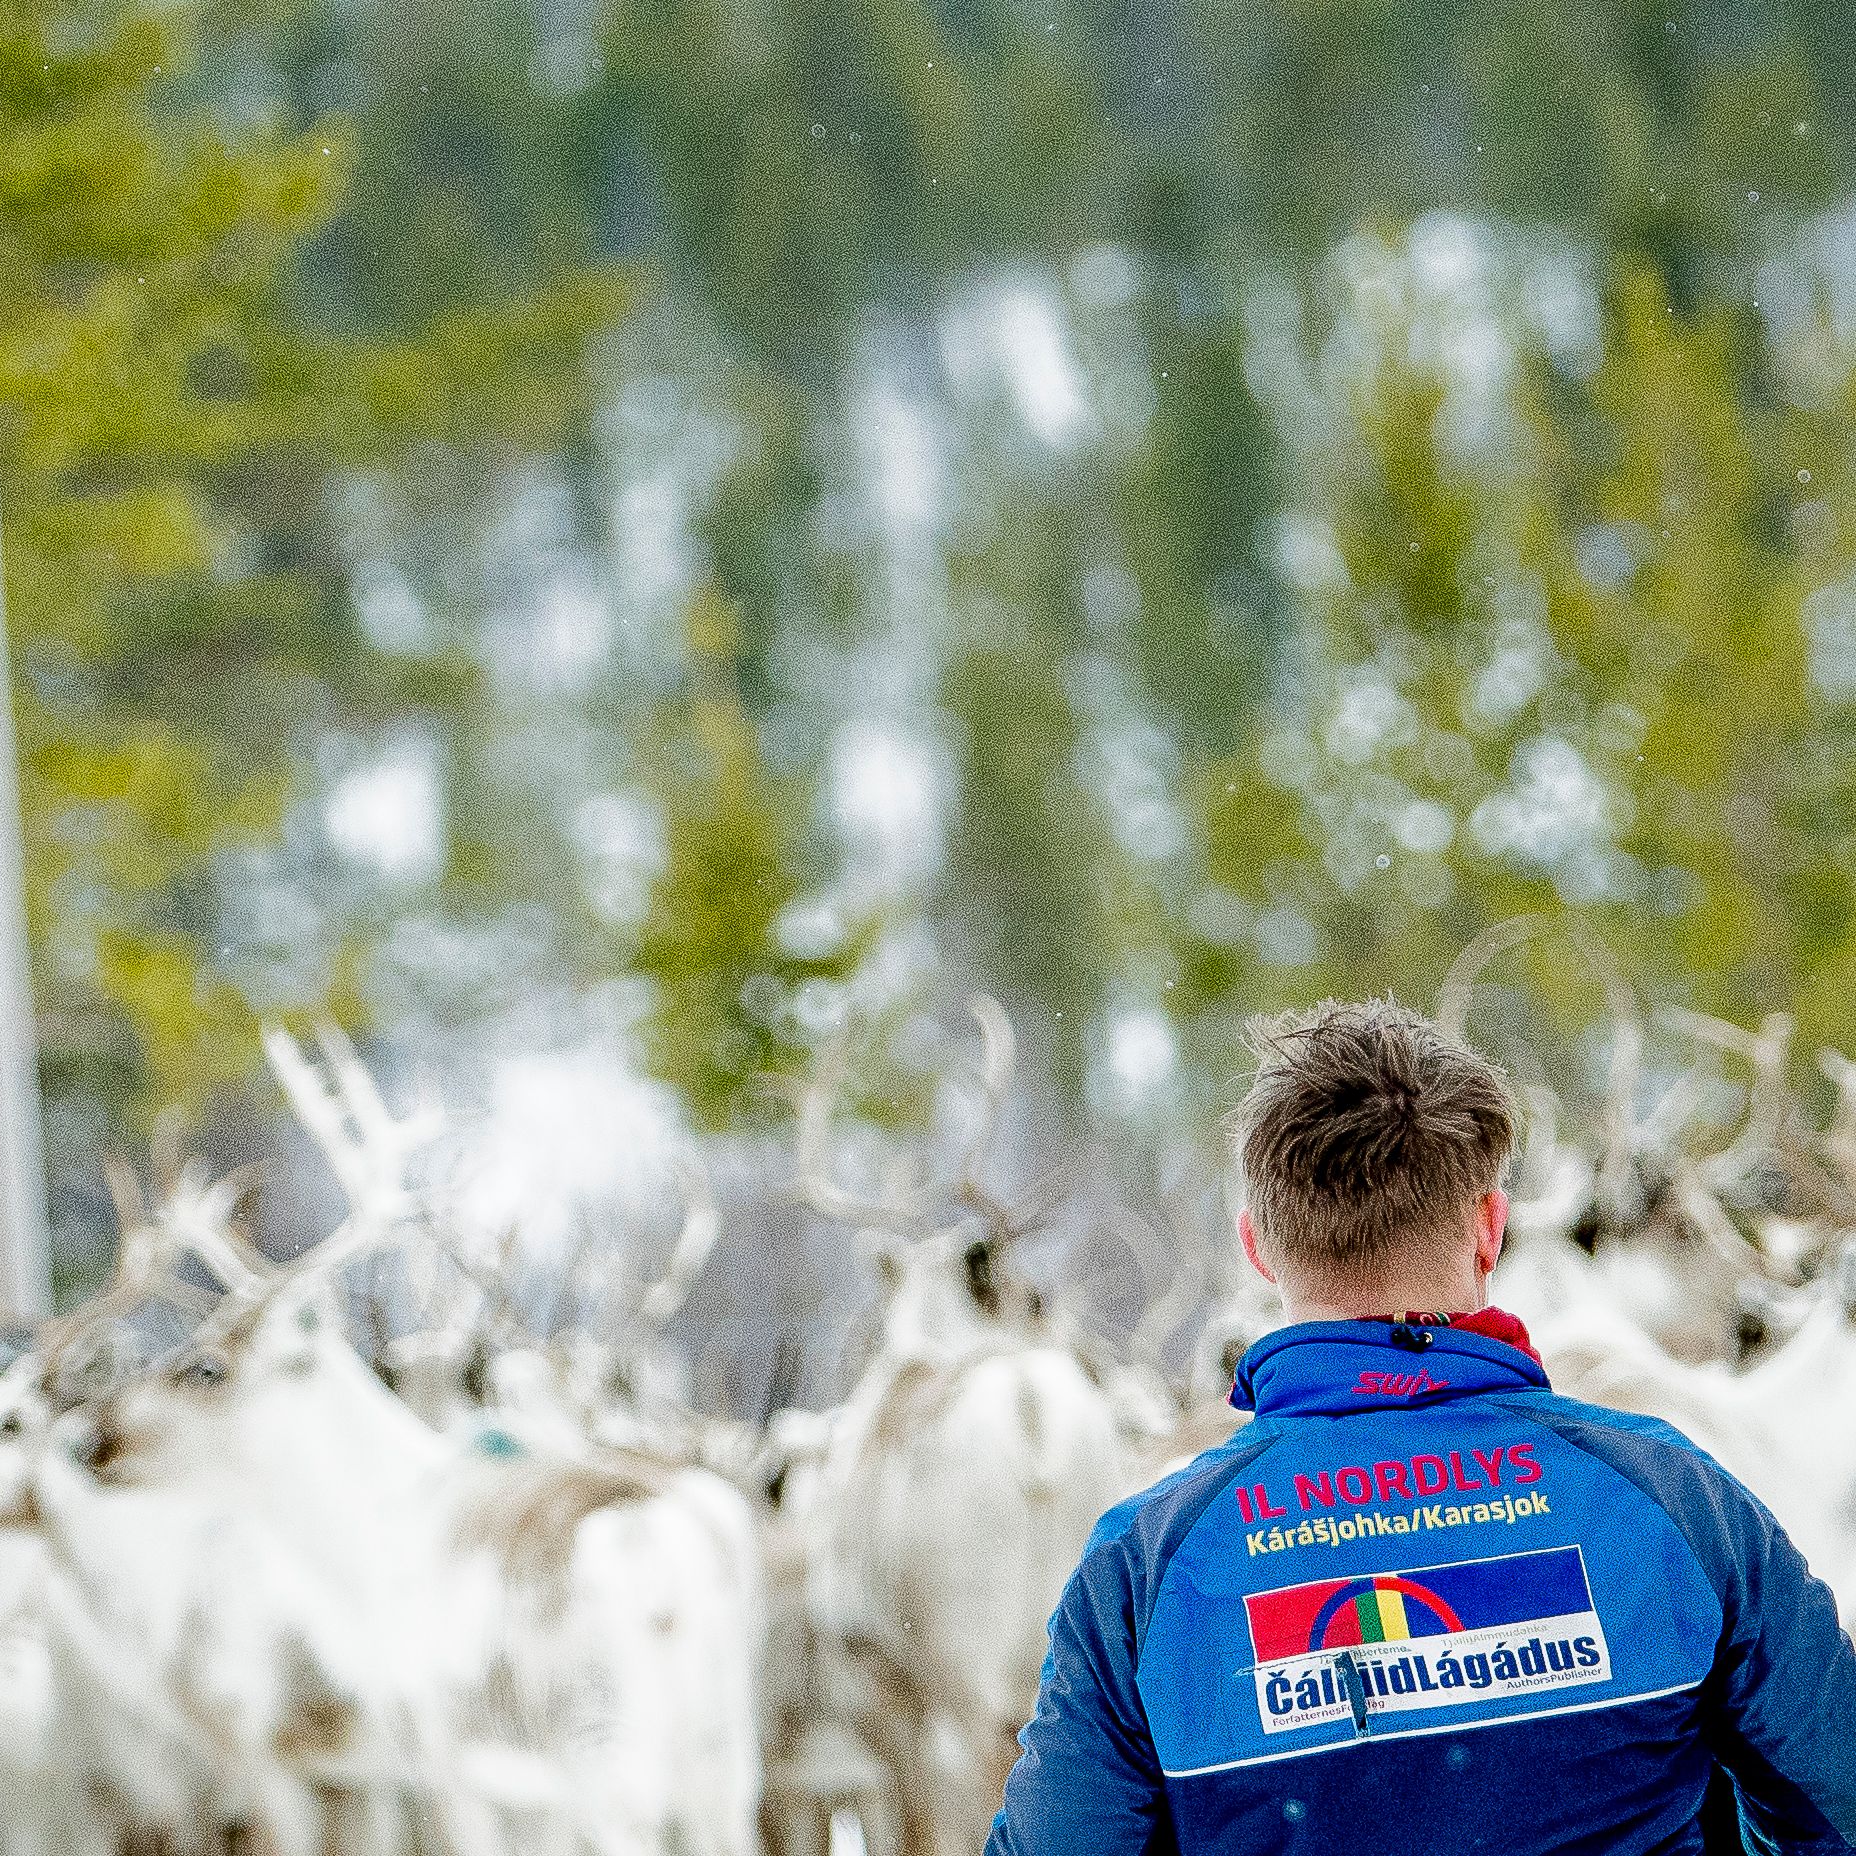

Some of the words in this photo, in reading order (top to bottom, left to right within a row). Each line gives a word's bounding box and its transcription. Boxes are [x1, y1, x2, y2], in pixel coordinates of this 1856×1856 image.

[1235, 1482, 1288, 1524] IL
[1293, 1443, 1543, 1512] NORDLYS
[1246, 1491, 1551, 1556] Kárášjohka/Karasjok
[1506, 1667, 1602, 1690] AuthorsPublisher
